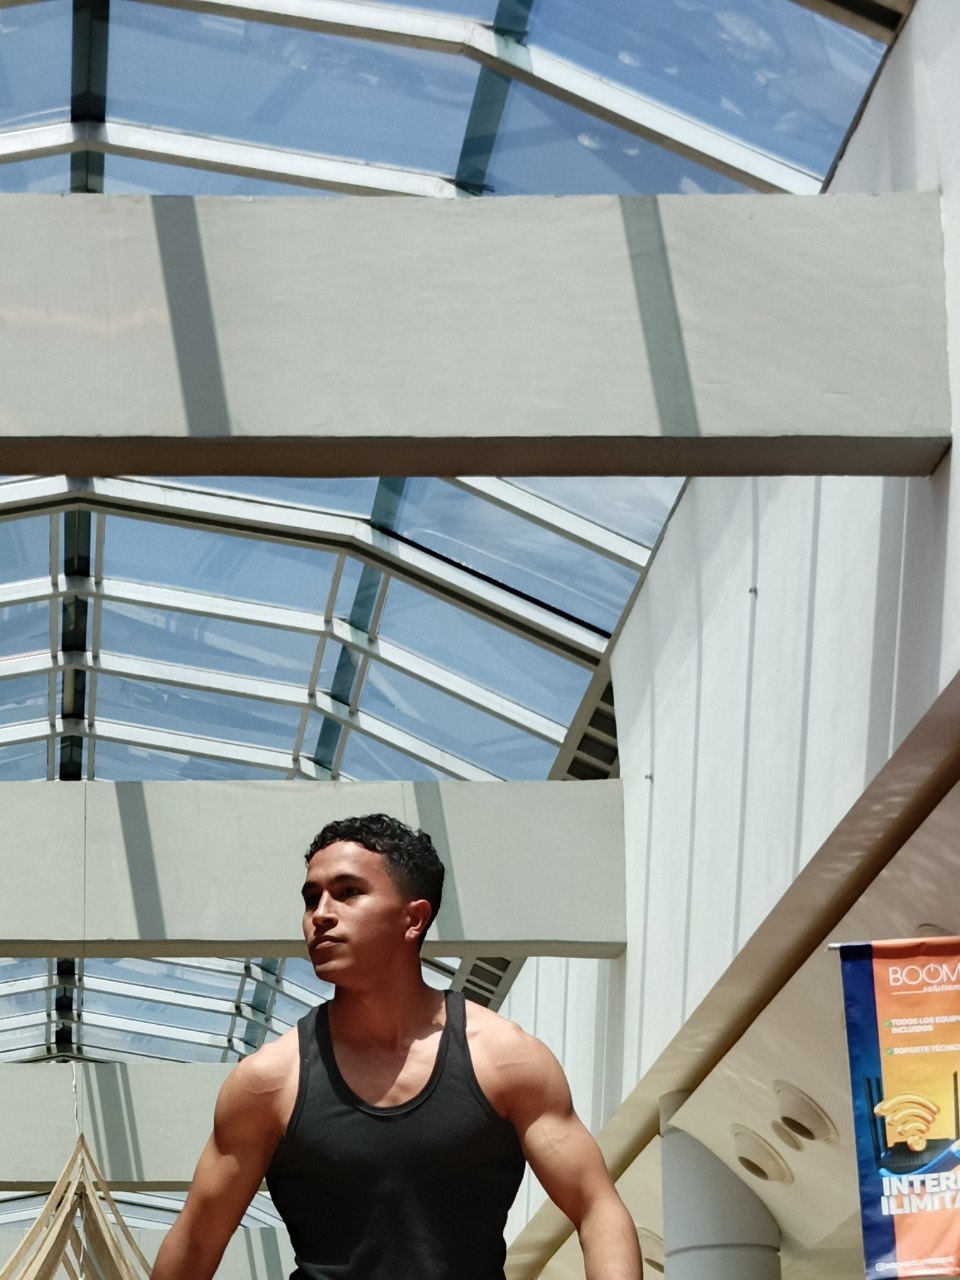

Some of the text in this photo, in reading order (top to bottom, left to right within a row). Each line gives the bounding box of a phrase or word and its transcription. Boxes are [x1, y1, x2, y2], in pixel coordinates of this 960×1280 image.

[888, 963, 960, 986] BOOM
[890, 1018, 918, 1027] TODOS
[919, 1016, 934, 1024] LOS
[882, 1172, 960, 1196] INTER
[881, 1191, 960, 1215] ILIMIT
